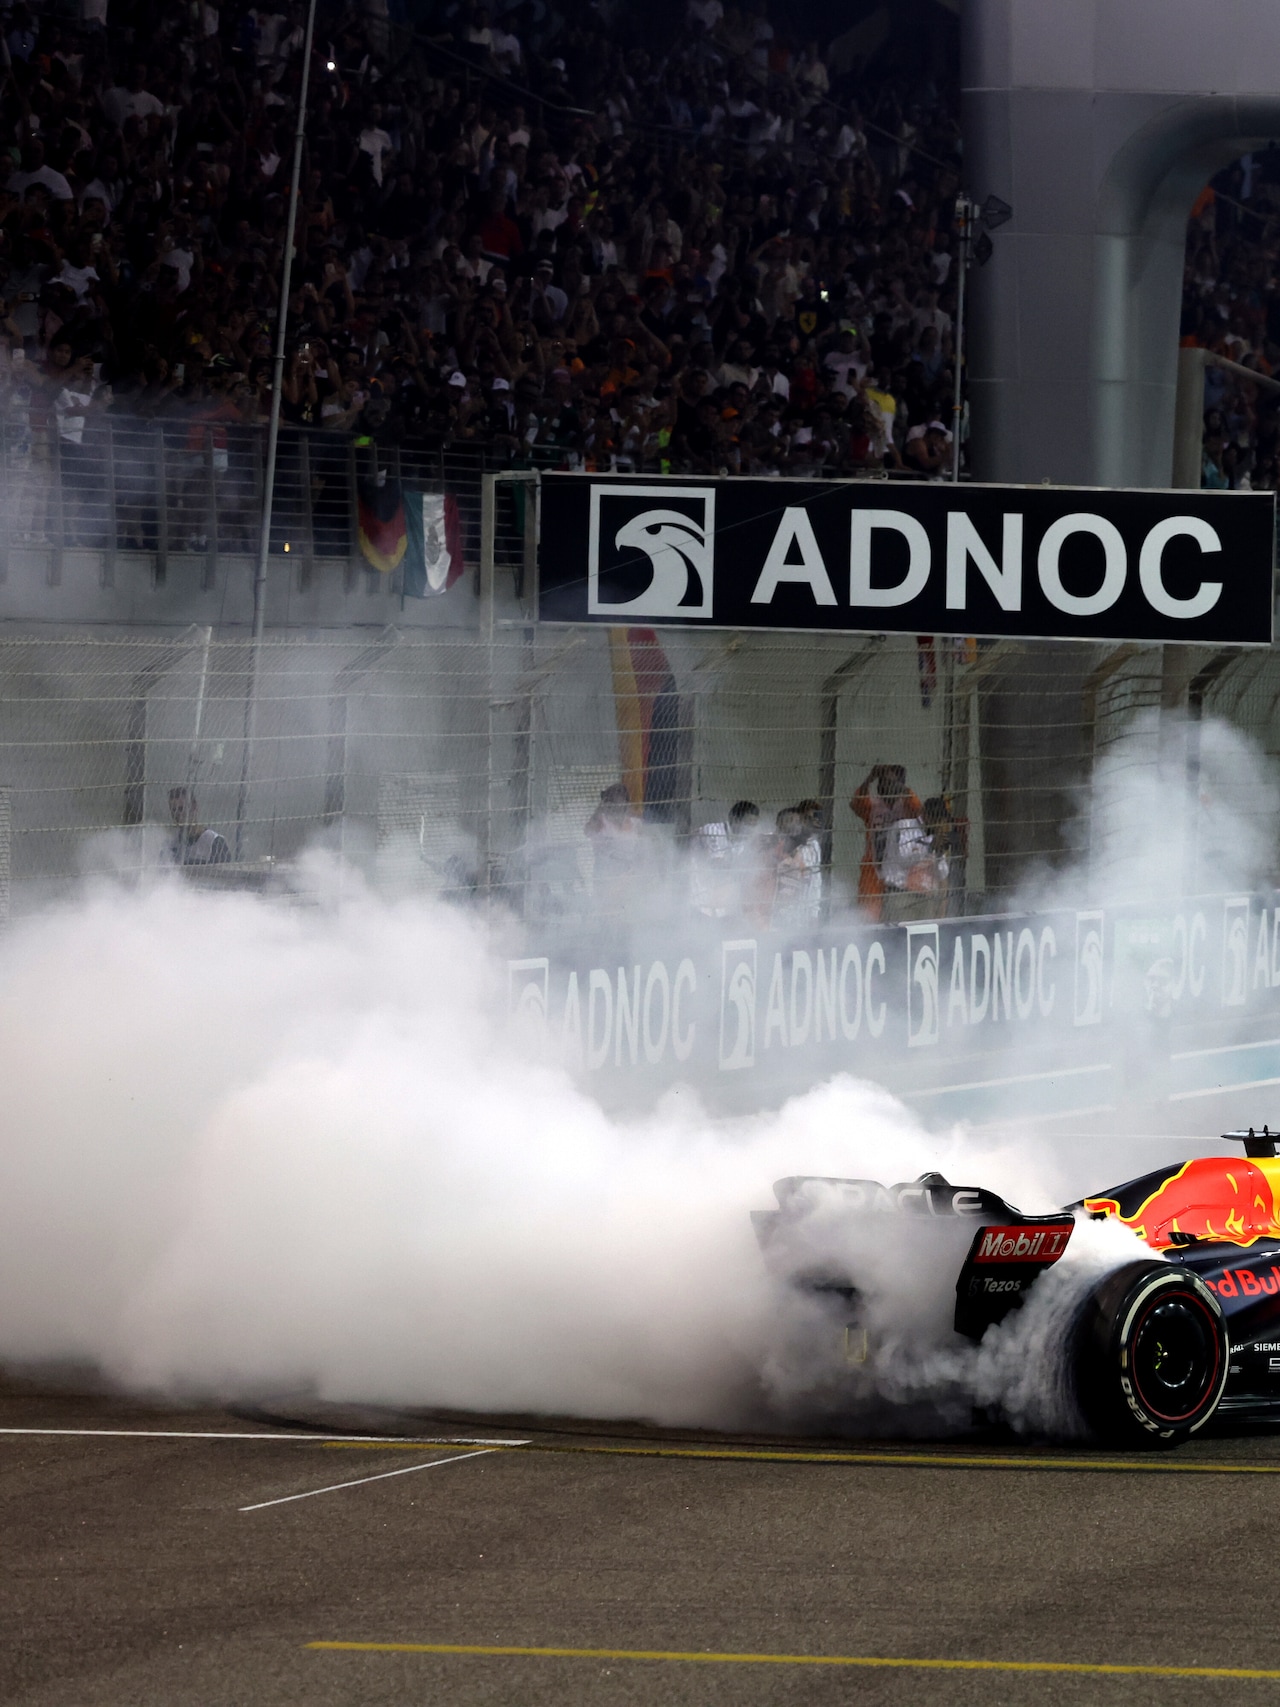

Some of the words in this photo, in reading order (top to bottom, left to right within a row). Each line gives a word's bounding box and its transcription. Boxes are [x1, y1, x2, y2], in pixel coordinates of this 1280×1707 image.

[751, 506, 1223, 619] ADNOC
[560, 958, 697, 1071] ADNOC
[765, 941, 886, 1050] ADNOC
[946, 926, 1057, 1028] ADNOC
[978, 1232, 1046, 1256] Mobil
[983, 1277, 1021, 1292] Tezos
